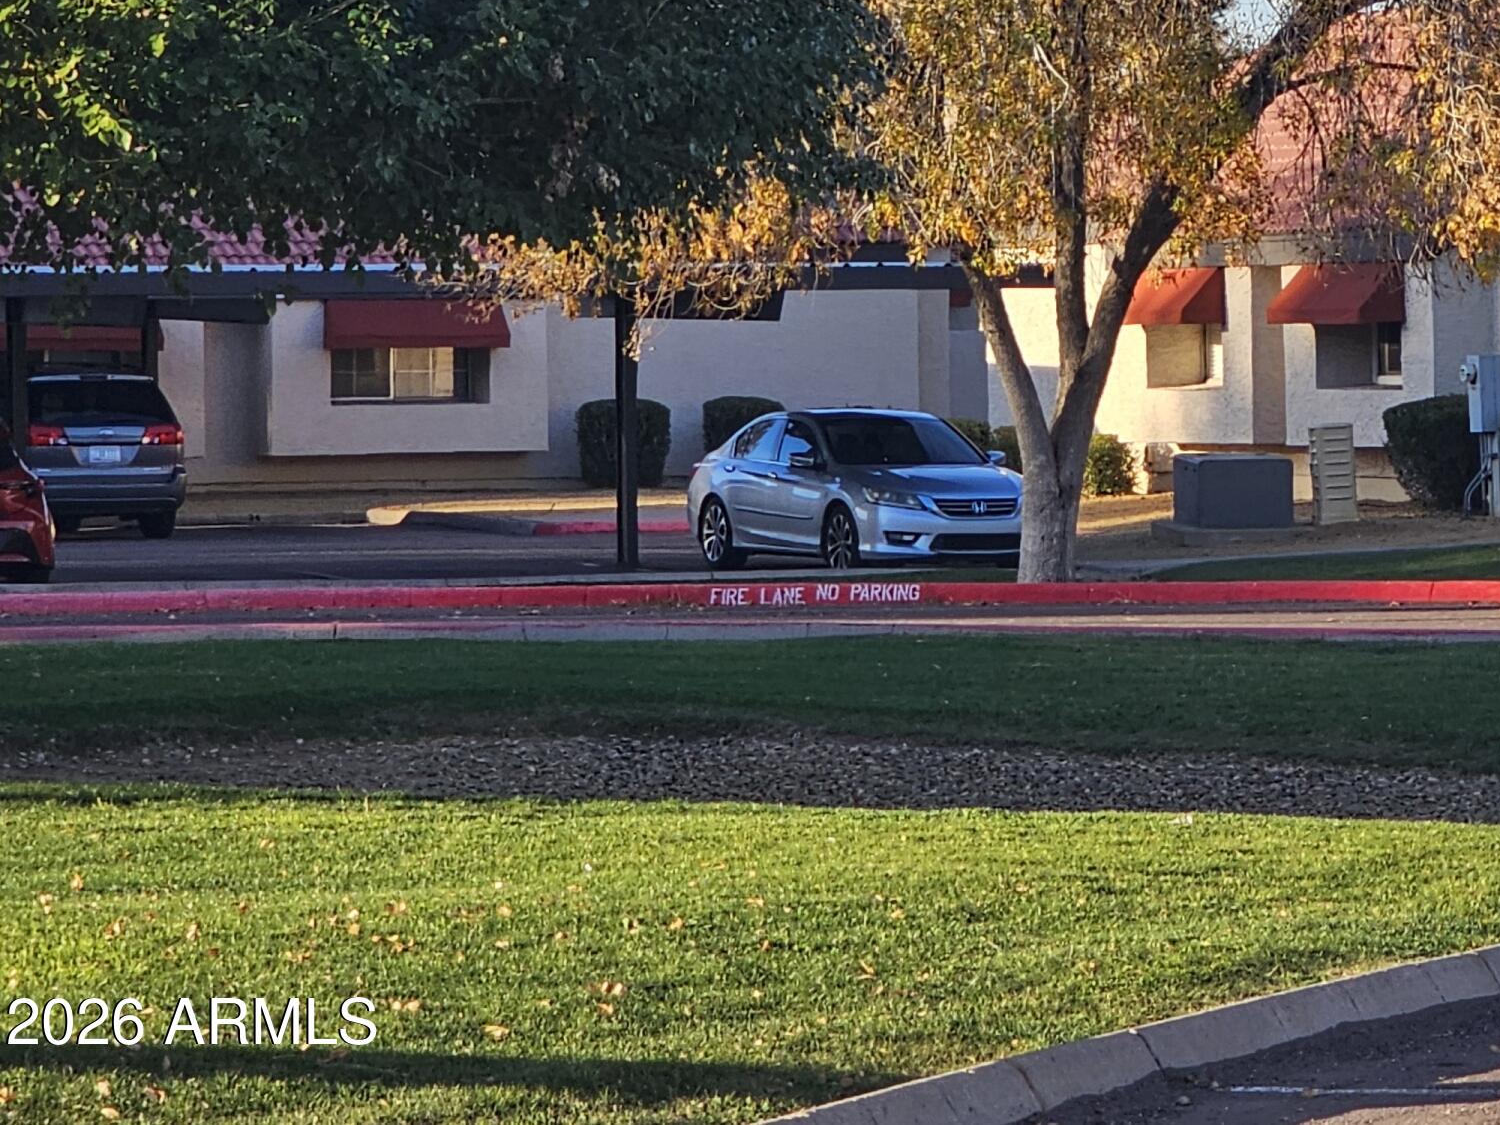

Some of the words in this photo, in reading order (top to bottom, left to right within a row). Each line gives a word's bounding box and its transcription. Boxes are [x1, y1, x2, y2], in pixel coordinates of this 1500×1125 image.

[710, 587, 749, 606] FIRE
[760, 586, 806, 606] LANE
[815, 583, 840, 602] NO
[849, 583, 920, 602] PARKING
